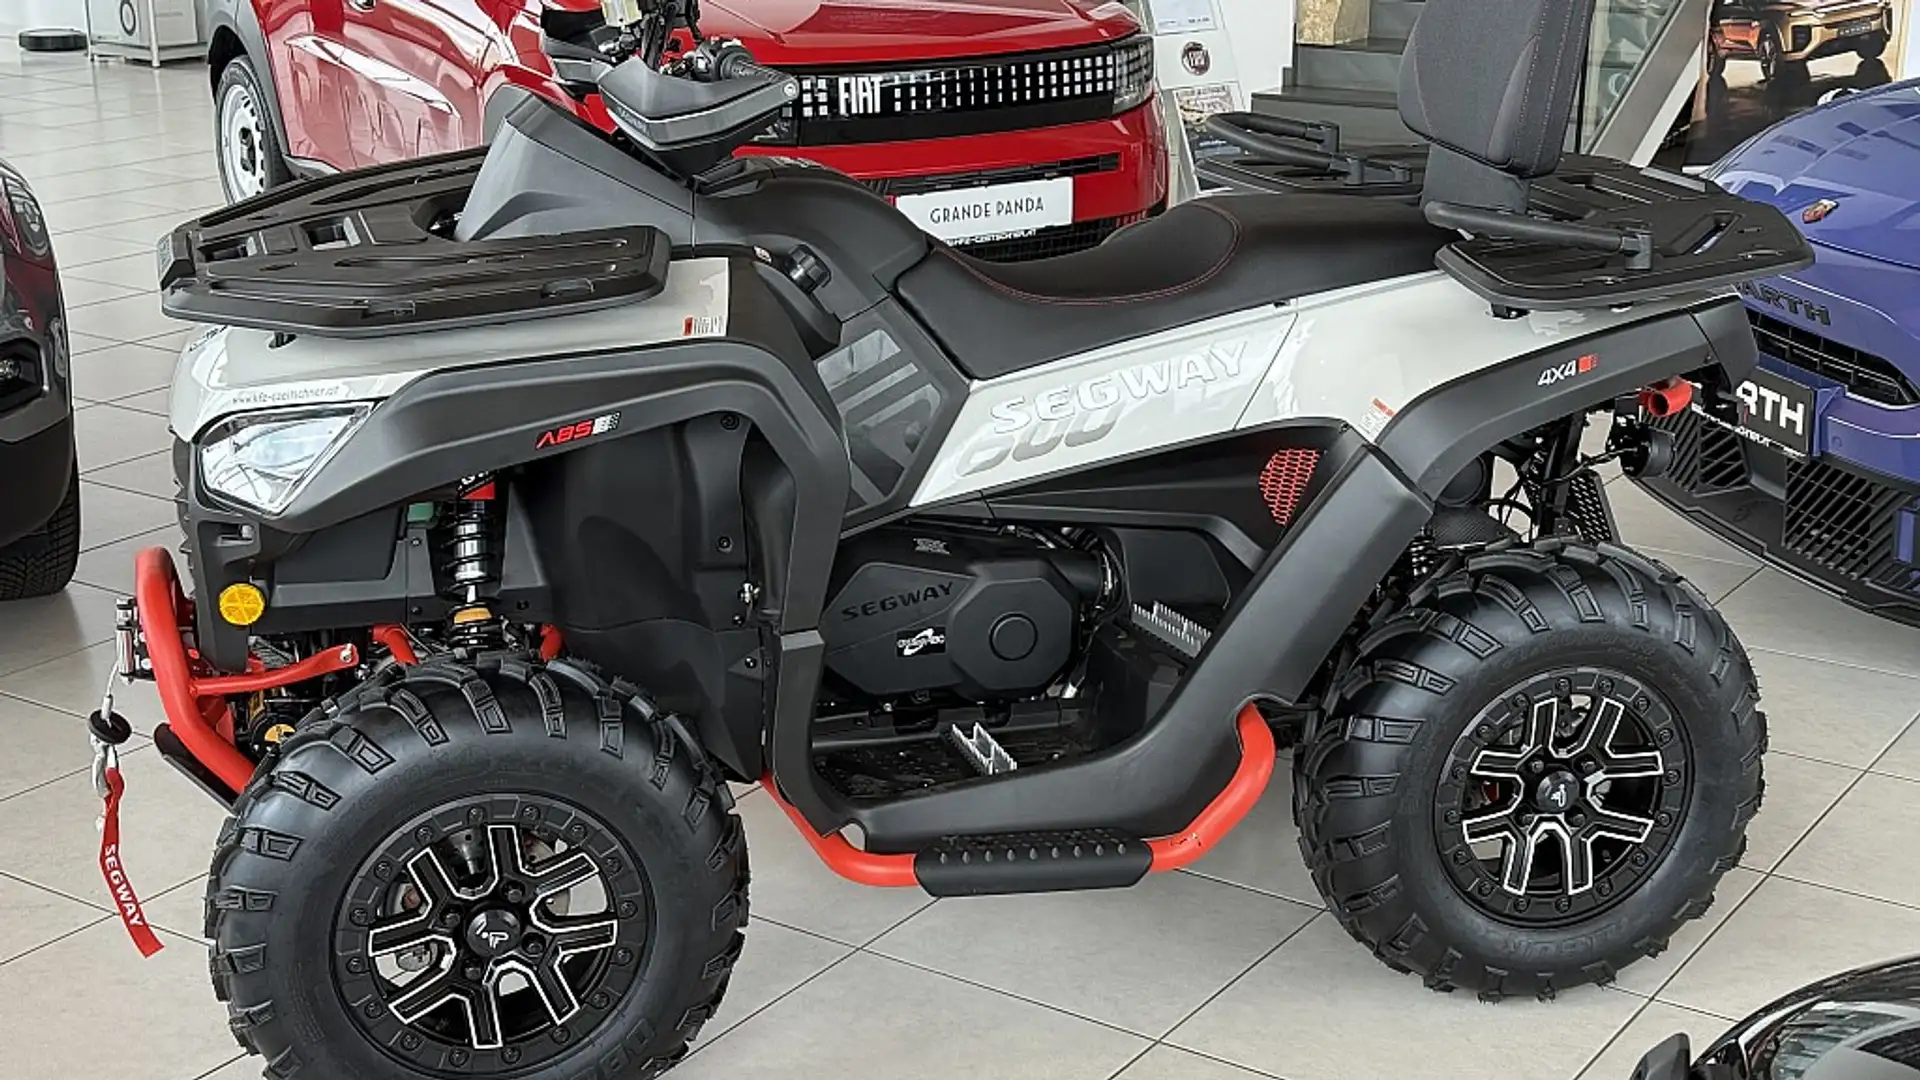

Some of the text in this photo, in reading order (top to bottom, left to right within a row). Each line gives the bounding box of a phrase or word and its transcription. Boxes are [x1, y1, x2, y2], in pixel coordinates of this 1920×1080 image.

[839, 76, 882, 115] FIAT
[930, 196, 1045, 224] GRANDE PANDA
[1737, 279, 1831, 326] ARTH
[990, 340, 1248, 434] SEGWAY
[1537, 359, 1577, 386] 4X4
[1736, 380, 1805, 436] RTH
[841, 581, 953, 621] SEGWAY
[105, 843, 145, 926] SEGWAY
